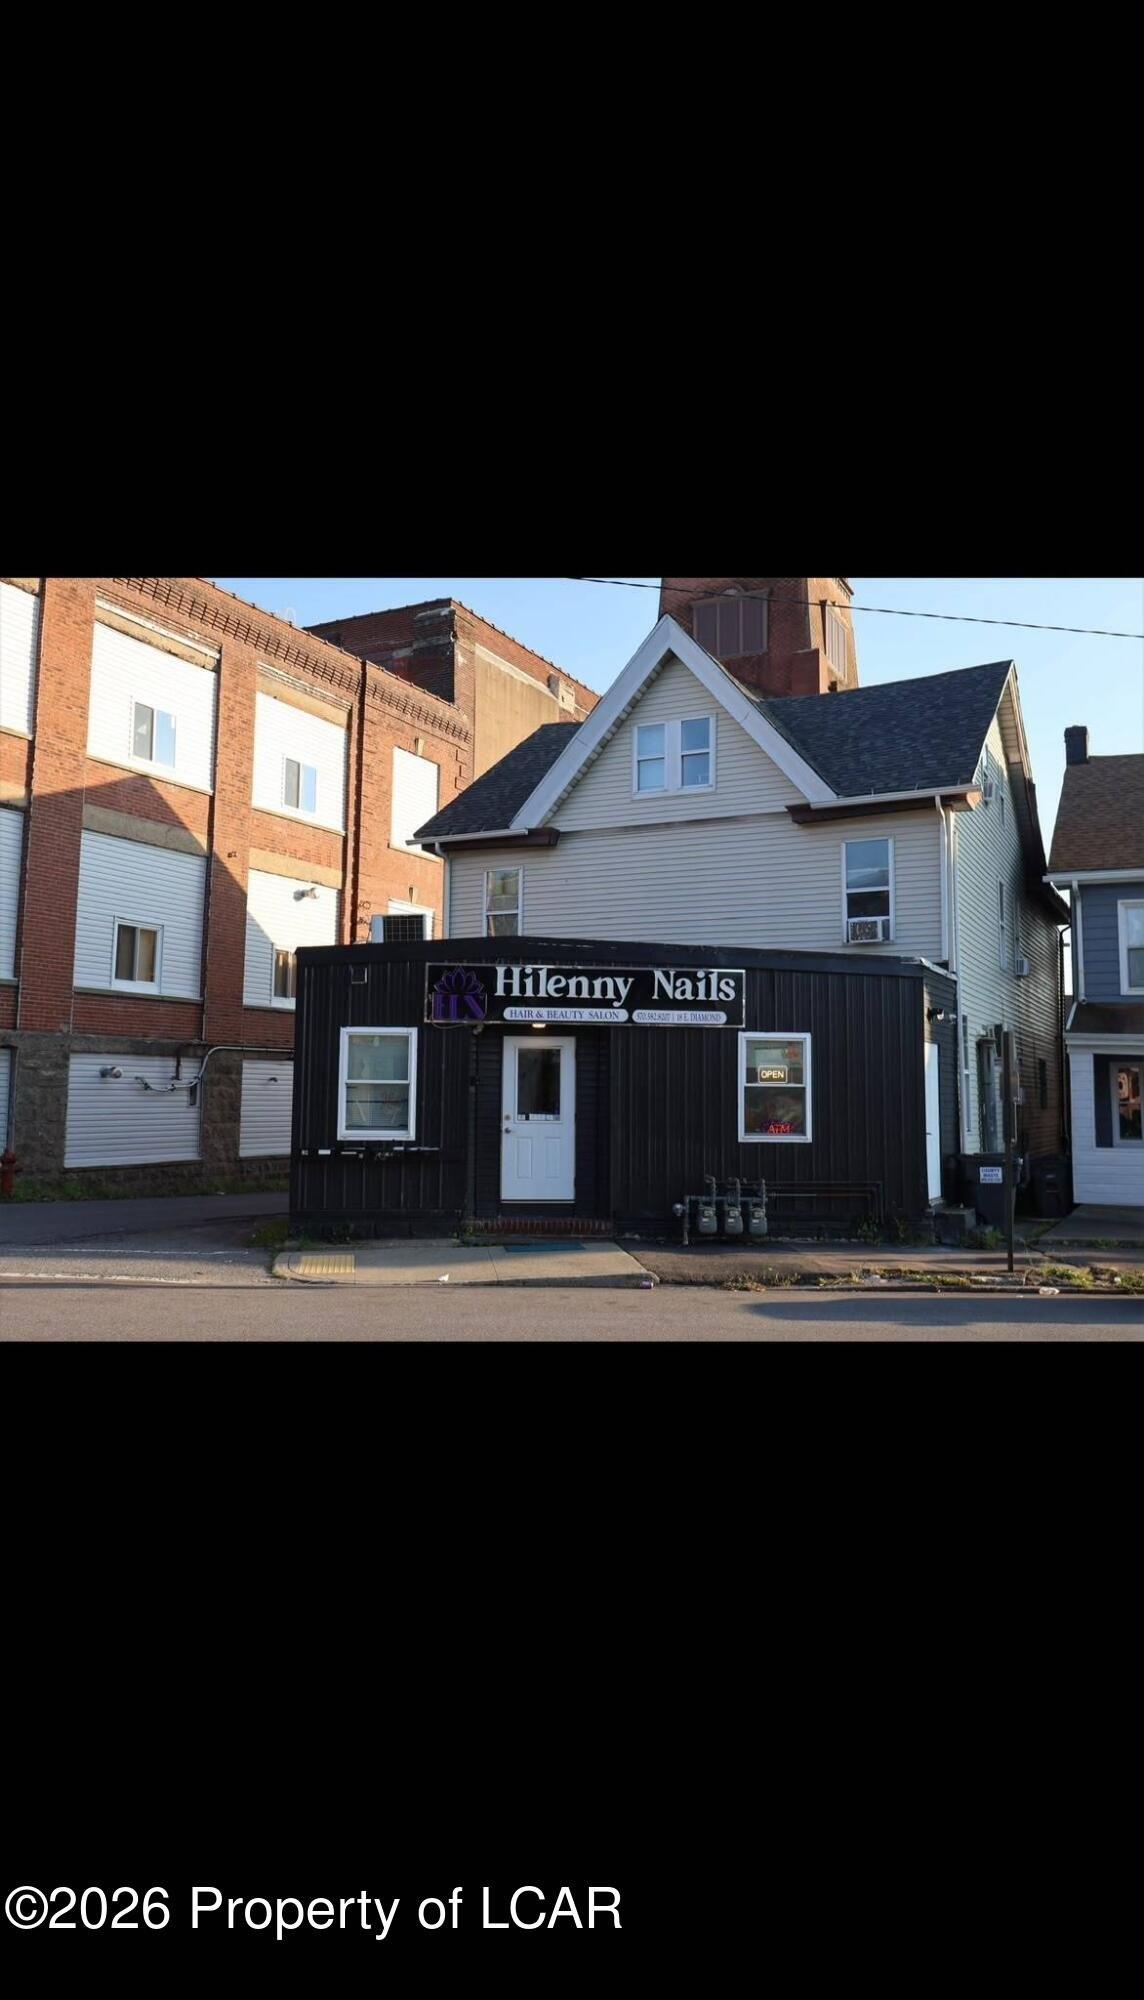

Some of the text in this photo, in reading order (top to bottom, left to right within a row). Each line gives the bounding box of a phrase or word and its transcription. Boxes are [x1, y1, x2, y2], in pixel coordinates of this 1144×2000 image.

[494, 967, 736, 1007] Hilenny Nails
[509, 1009, 619, 1020] HAIR & BEAUTY SALON
[690, 1013, 722, 1022] DIAMOND
[760, 1070, 785, 1079] OPEN
[768, 1124, 791, 1134] ATM
